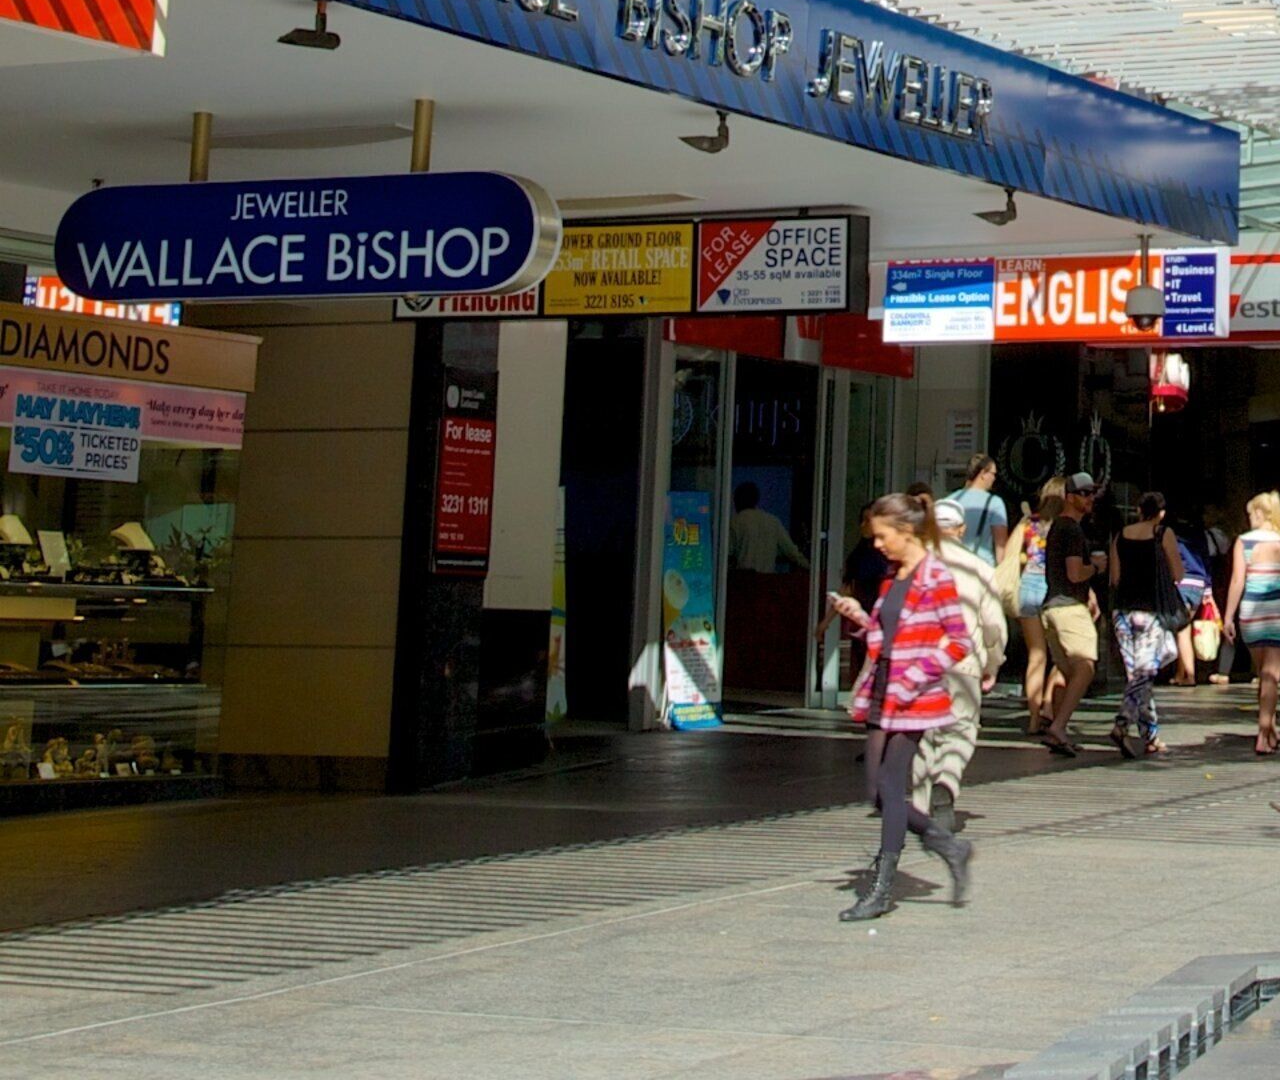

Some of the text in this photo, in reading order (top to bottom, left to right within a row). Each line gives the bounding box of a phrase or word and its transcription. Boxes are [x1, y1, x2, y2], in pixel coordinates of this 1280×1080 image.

[806, 27, 996, 146] JEWELLER
[231, 190, 348, 220] JEWELLER
[562, 230, 682, 249] OWER GROUND FLOOR
[702, 226, 735, 261] FOR
[766, 226, 841, 246] OFFICE
[77, 235, 306, 289] WALLACE
[591, 249, 642, 270] RETAIL
[646, 246, 689, 269] SPACE
[707, 229, 755, 282] LEASE
[765, 246, 841, 268] SPACE
[998, 259, 1046, 271] LEARN:
[573, 270, 662, 287] NOW AVAILABLE!
[736, 271, 766, 281] 35-55
[794, 269, 841, 280] available
[925, 269, 955, 281] Single
[957, 269, 983, 279] Floor
[1172, 265, 1215, 275] Business
[1171, 279, 1181, 289] IT
[583, 295, 608, 309] 3221
[611, 294, 635, 308] 8195
[928, 293, 956, 304] Lease
[958, 291, 990, 305] Option
[1171, 292, 1202, 302] Travel
[1183, 323, 1206, 333] Level
[0, 320, 170, 374] DIAMONDS
[16, 393, 141, 430] MAY MAYHEM!
[172, 405, 197, 420] every
[198, 405, 215, 420] day
[445, 421, 492, 442] For lease
[80, 432, 138, 452] TICKETED
[441, 493, 489, 516] 3231 1311
